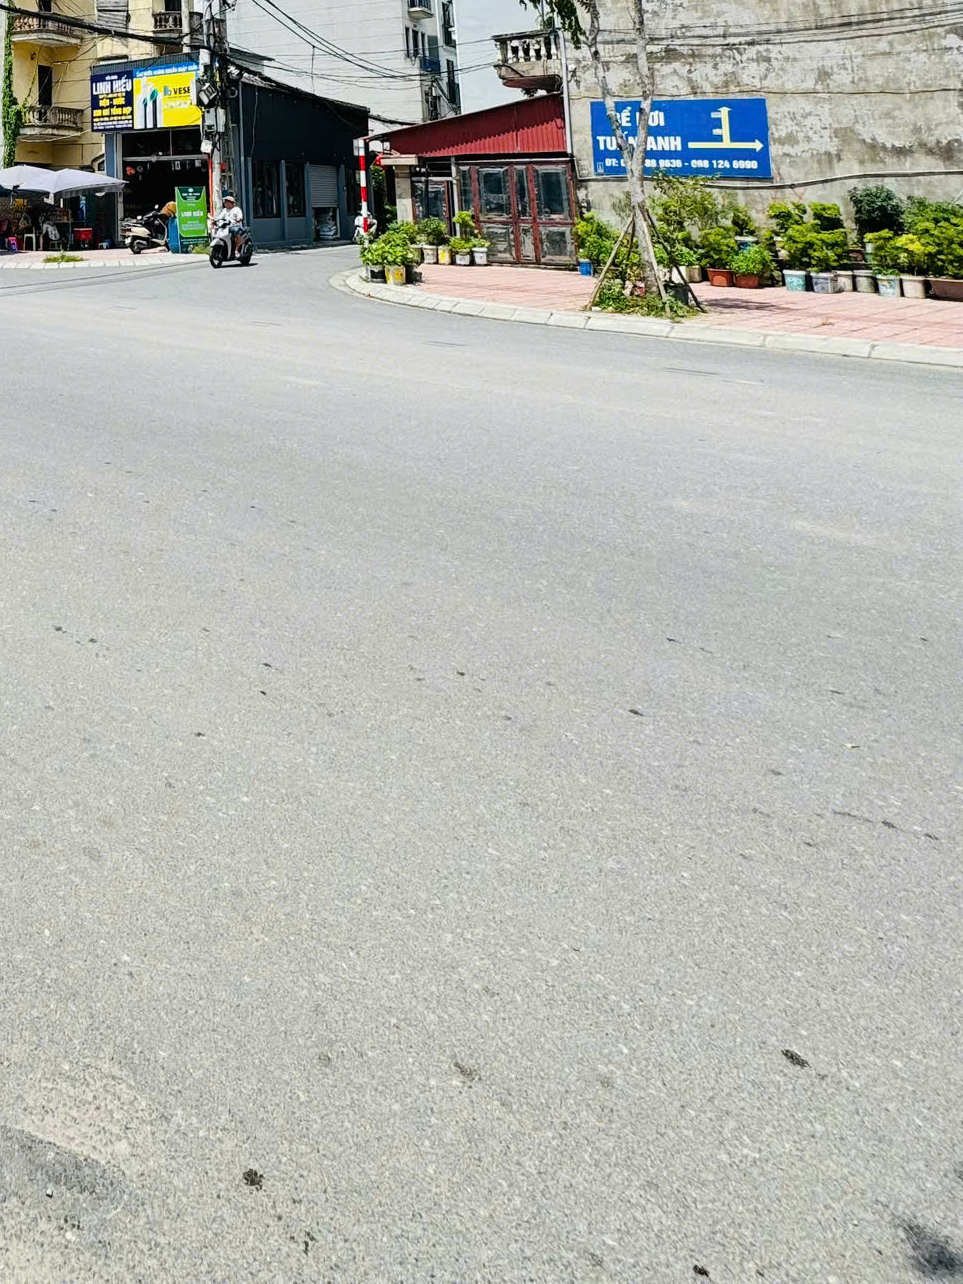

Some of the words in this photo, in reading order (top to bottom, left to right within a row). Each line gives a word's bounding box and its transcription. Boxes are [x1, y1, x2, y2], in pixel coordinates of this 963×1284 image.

[93, 81, 111, 95] LINH
[635, 110, 666, 127] ƠI
[645, 136, 682, 151] ANH
[711, 159, 731, 169] 124
